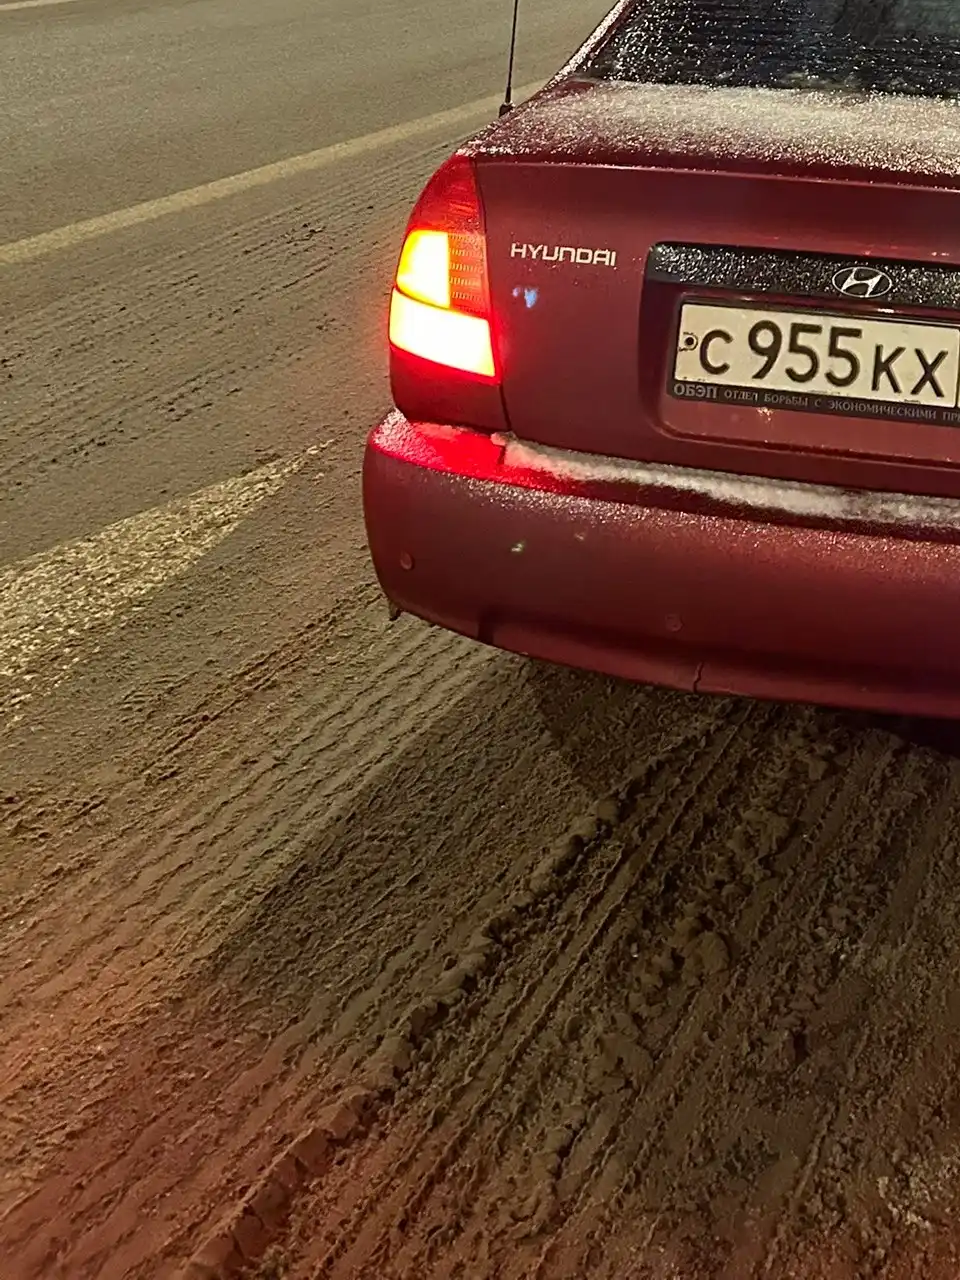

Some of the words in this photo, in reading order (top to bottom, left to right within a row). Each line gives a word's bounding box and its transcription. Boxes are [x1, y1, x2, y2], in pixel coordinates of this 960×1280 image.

[510, 242, 617, 266] HYUNDAI
[673, 383, 718, 400] ОБЭП
[724, 389, 759, 402] ОТДЕЛ
[764, 393, 809, 407] БОРЬБЫ
[829, 401, 937, 420] ЭКОНОМИЧЕСКИМИ
